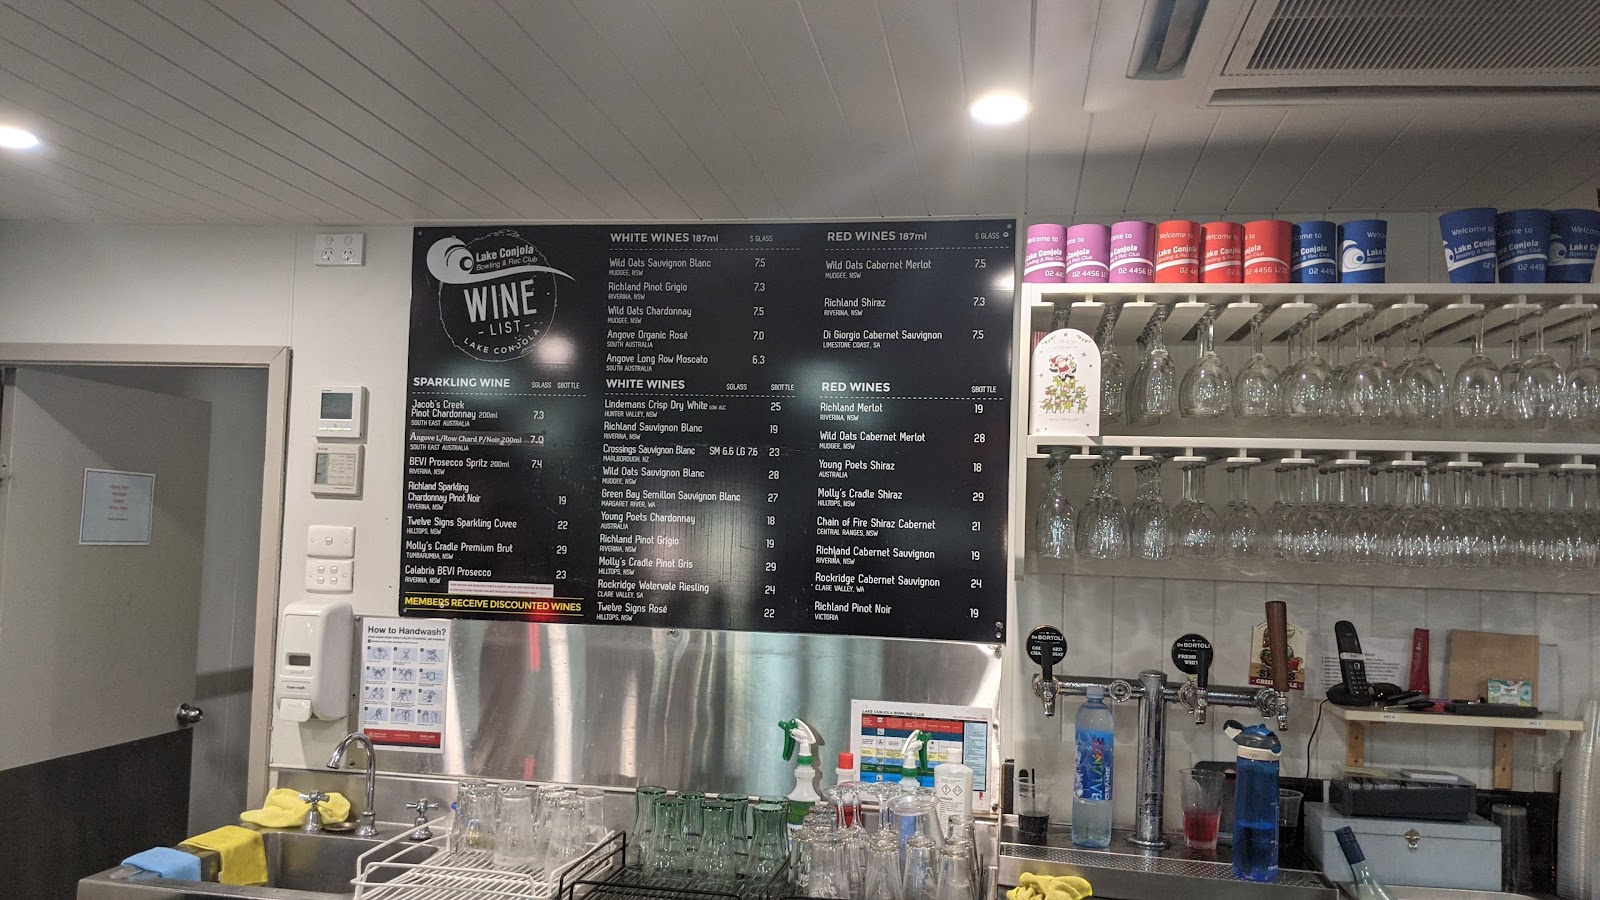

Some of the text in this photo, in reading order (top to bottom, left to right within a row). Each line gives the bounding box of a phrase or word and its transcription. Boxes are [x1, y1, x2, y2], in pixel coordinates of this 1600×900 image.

[611, 233, 648, 242] WHITE
[651, 233, 689, 242] WINES
[827, 232, 852, 241] RED
[855, 232, 896, 240] WINES
[476, 244, 534, 262] Lake Conjola
[1114, 245, 1137, 255] Conjola
[1301, 245, 1327, 255] Conjola
[476, 261, 500, 271] Bowling
[610, 258, 711, 269] Wild Oats Sauvignon Blanc
[755, 258, 765, 267] 7.5
[464, 280, 537, 322] WINE
[490, 320, 520, 336] LIST
[607, 330, 635, 340] Angove
[638, 330, 666, 341] Organic
[753, 331, 764, 340] 7.0
[824, 330, 942, 341] Di Giorgio Cabernet Sauvignon
[973, 330, 984, 339] 7.5
[464, 328, 540, 354] LAKE CONJOLA
[606, 354, 634, 364] Angove
[637, 355, 655, 365] Long
[676, 355, 708, 363] Moscato
[752, 355, 765, 364] 6.3
[413, 378, 510, 387] SPARKLING WINE
[606, 379, 685, 389] WHITE WINES
[822, 382, 890, 392] RED WINES
[412, 400, 464, 409] Jacob's Creek
[411, 409, 430, 418] Pinot
[432, 409, 476, 420] Chardonnay
[534, 411, 544, 419] 7.3
[603, 444, 695, 456] Crossings Sauvignon Blanc
[709, 447, 720, 455] SM
[723, 447, 734, 455] 6.6
[736, 447, 745, 456] LG
[769, 448, 780, 456] 23
[409, 457, 426, 466] BEVI
[429, 458, 463, 467] Prosecco
[466, 459, 487, 468] Spritz
[819, 459, 895, 470] Young Poets Shiraz
[973, 463, 982, 472] 18
[602, 489, 740, 502] Green Bay Semillon Sauvignon Blanc
[768, 494, 778, 502] 27
[817, 516, 935, 529] Chain of Fire Shiraz Cabernet
[972, 522, 981, 531] 21
[406, 542, 512, 552] Molly's Cradle Premium Brut
[557, 546, 567, 554] 29
[598, 579, 709, 594] Rockridge Watervale Riesling
[765, 585, 775, 594] 24
[405, 597, 581, 611] MEMBERS RECEIVE DISCOUNTED WINES
[815, 601, 891, 614] Richland Pinot Noir
[970, 609, 978, 618] 19
[399, 627, 446, 635] Handwash?
